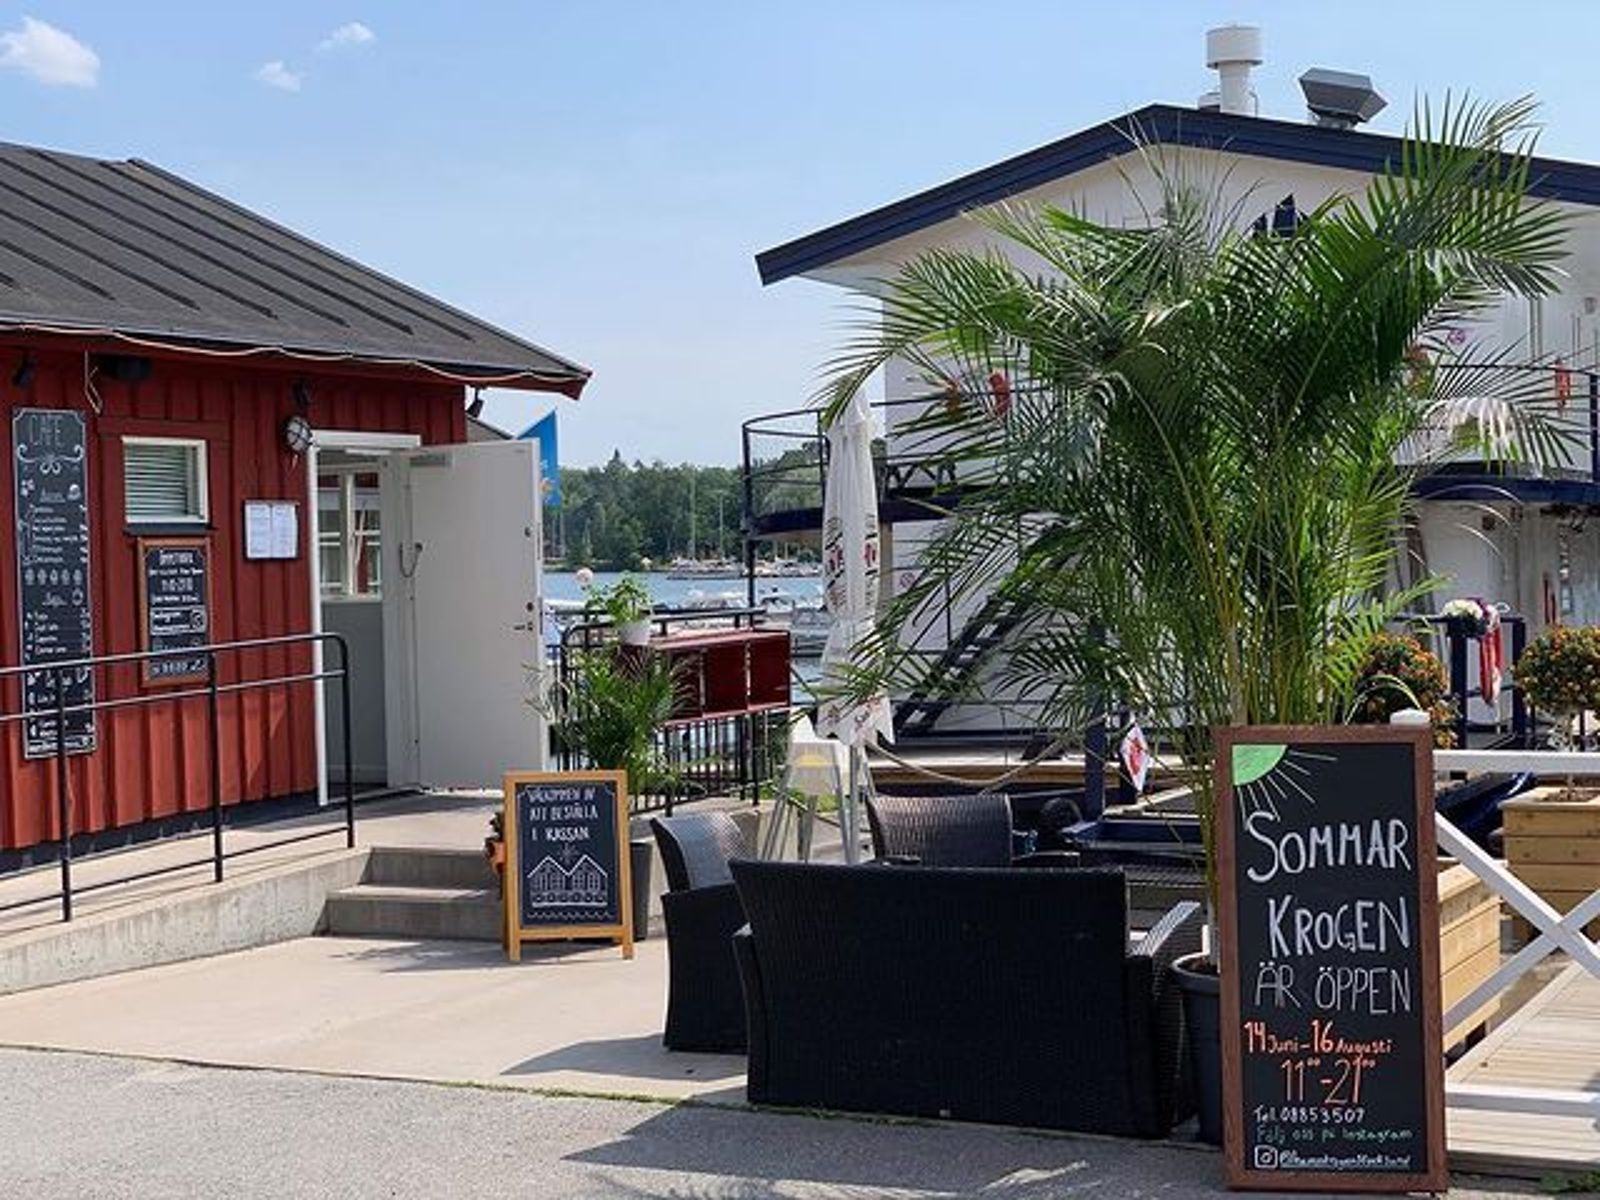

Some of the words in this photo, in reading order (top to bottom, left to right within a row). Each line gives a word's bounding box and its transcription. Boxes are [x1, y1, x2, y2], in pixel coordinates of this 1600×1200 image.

[1247, 811, 1411, 883] SOMMAR
[1268, 894, 1410, 958] KROGEN
[1255, 961, 1301, 1008] ÄR
[1315, 966, 1412, 1014] ÖPPEN
